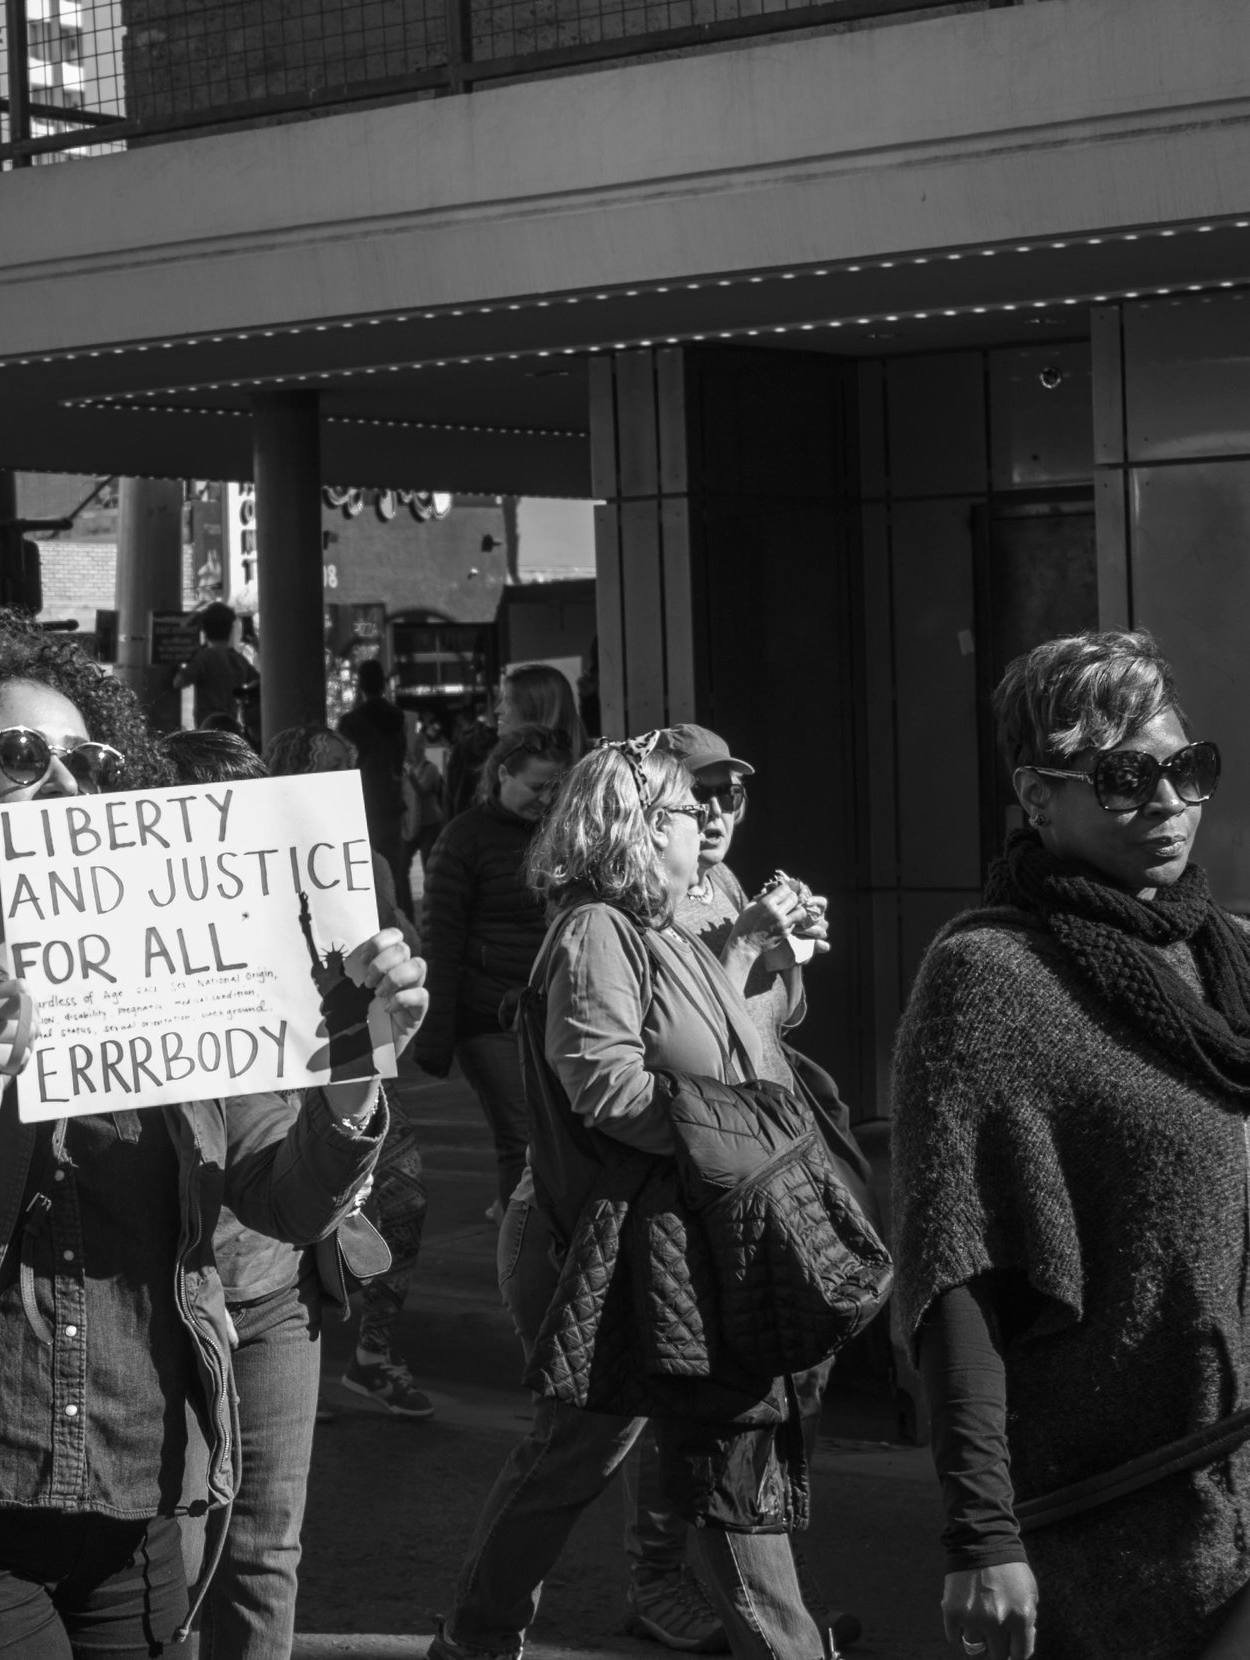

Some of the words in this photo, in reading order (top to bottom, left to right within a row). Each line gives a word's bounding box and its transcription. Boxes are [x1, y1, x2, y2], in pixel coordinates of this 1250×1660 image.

[0, 789, 234, 861] LIBERTY
[8, 865, 124, 920] AND
[148, 838, 371, 908] JUSTICE
[11, 934, 117, 985] FOR
[144, 922, 248, 978] ALL
[83, 991, 94, 1005] of
[36, 1020, 288, 1103] ERRRBODY
